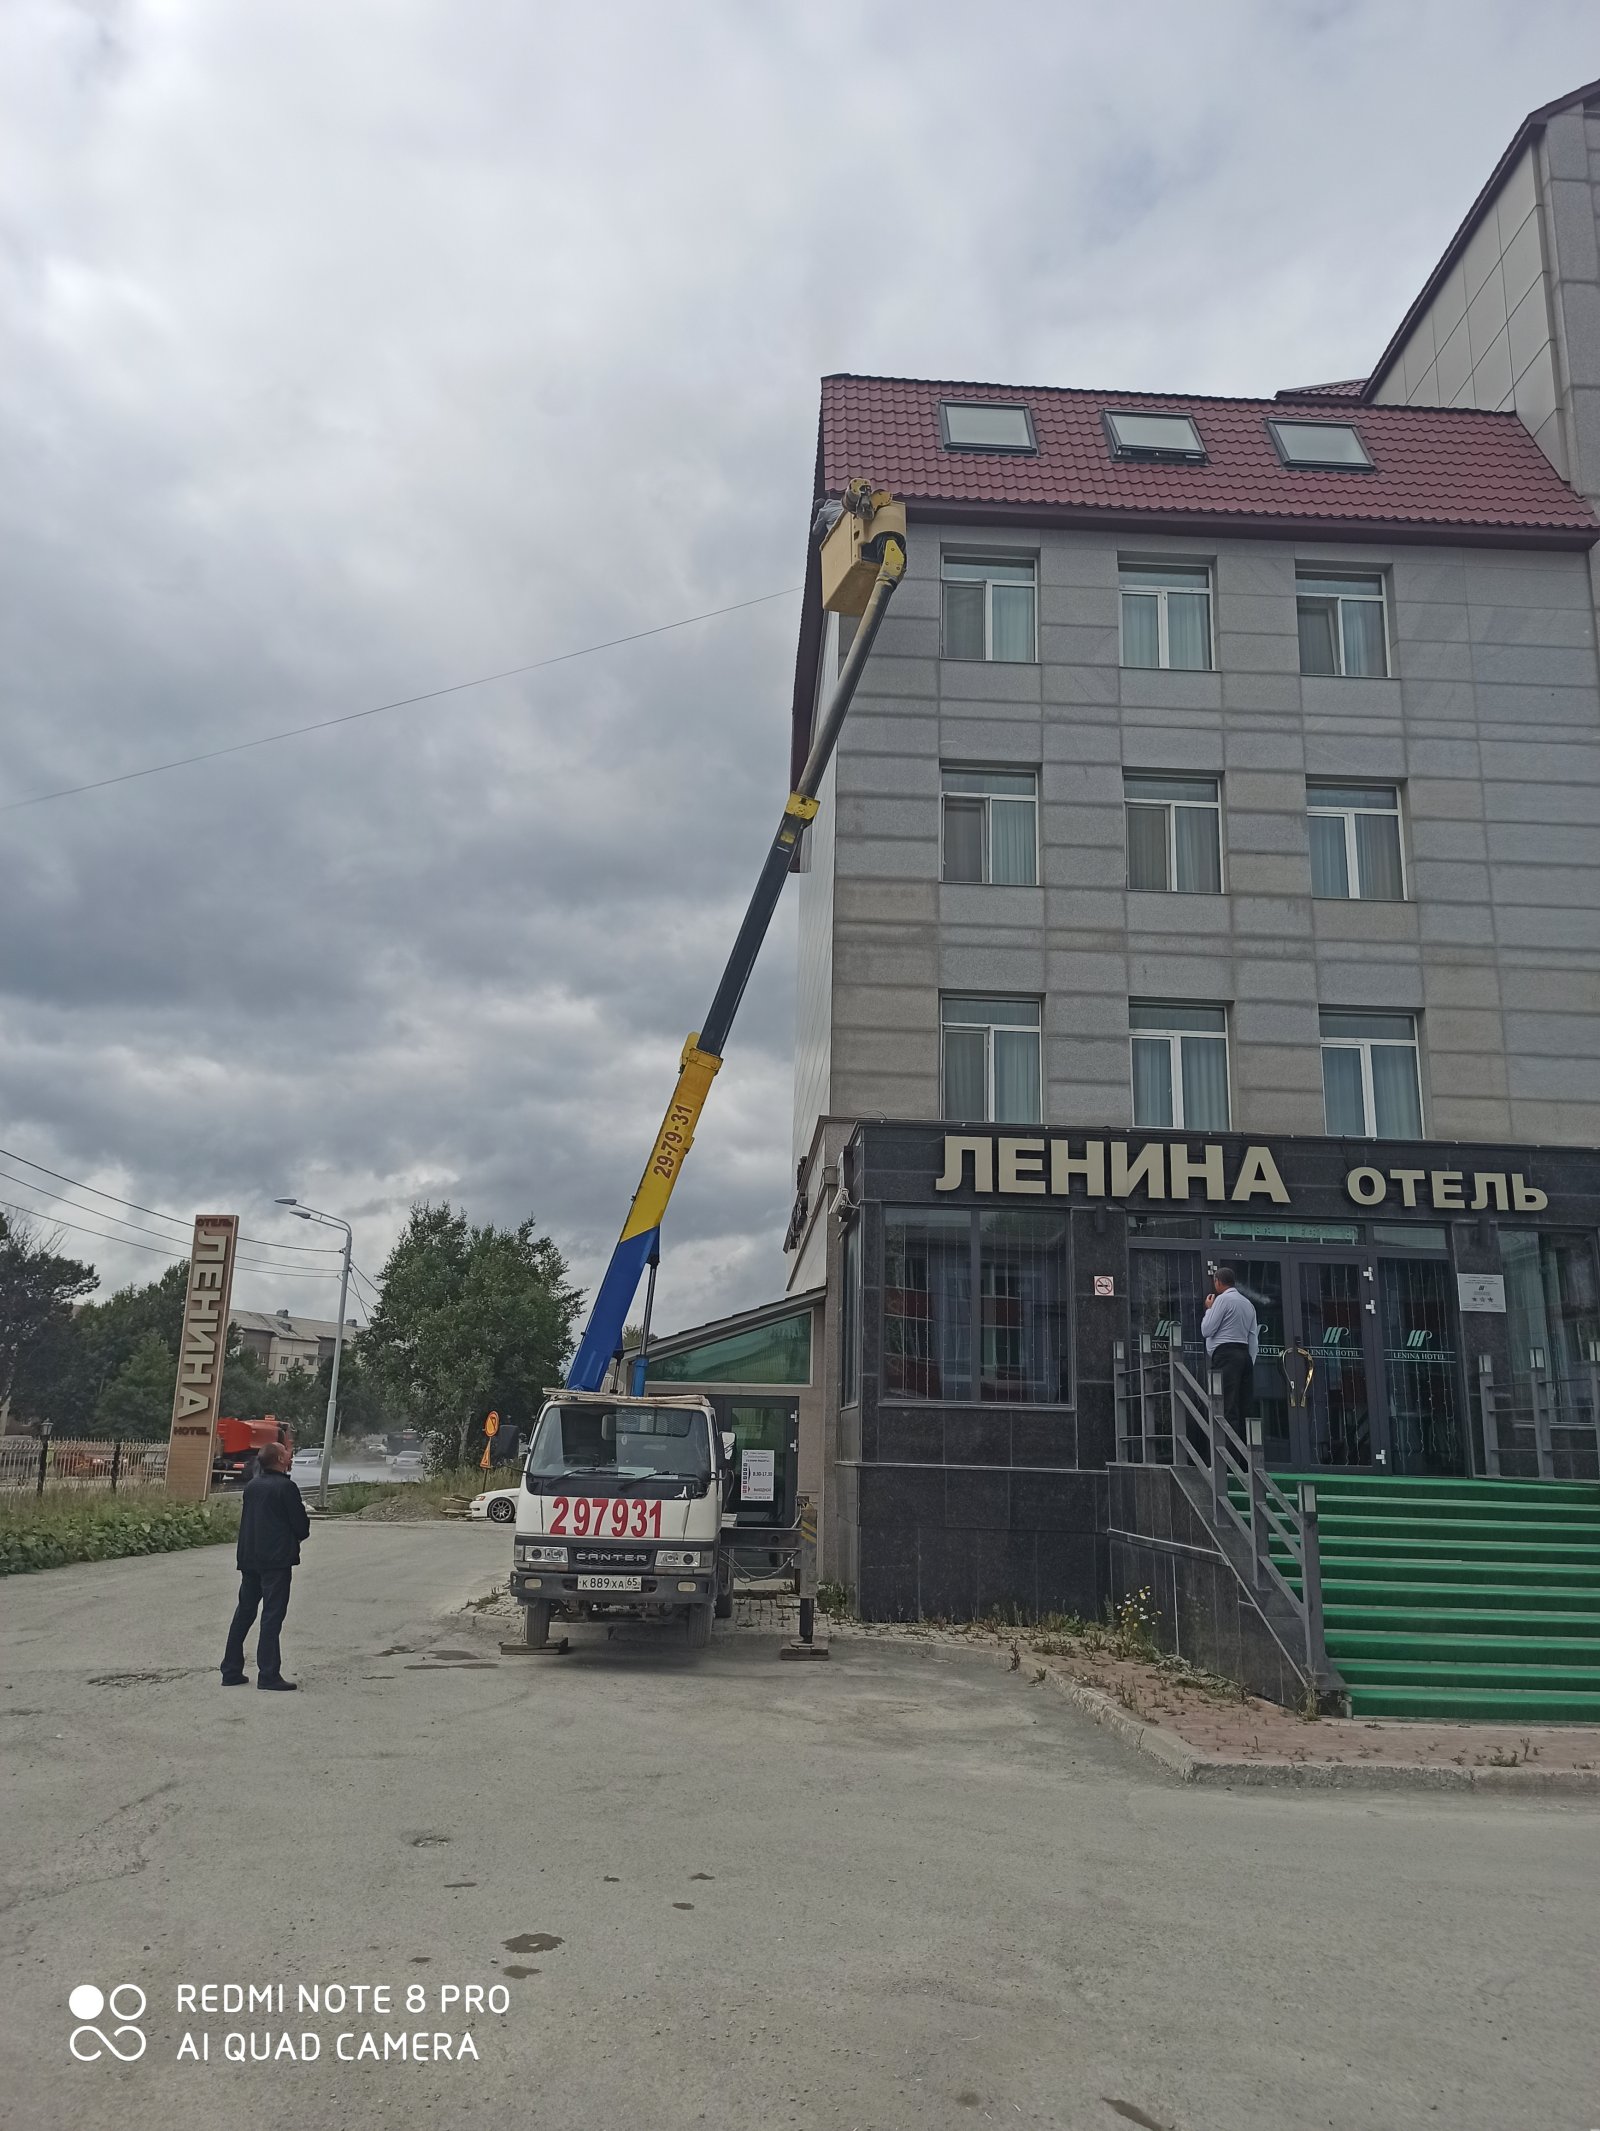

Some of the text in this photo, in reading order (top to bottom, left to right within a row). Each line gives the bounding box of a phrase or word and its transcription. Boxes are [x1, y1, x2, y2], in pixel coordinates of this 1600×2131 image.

[653, 1104, 693, 1180] 29-79-31
[935, 1135, 1549, 1212] ЛЕНИНА ОТЕЛЬ
[196, 1218, 234, 1227] ОТЕЛЬ
[177, 1230, 228, 1419] ЛЕНИНА
[1307, 1348, 1334, 1356] LENINA
[1393, 1352, 1446, 1361] LENINA HOTEL
[173, 1426, 210, 1436] HOTEL
[549, 1496, 662, 1539] 297931
[576, 1553, 648, 1562] CANTER
